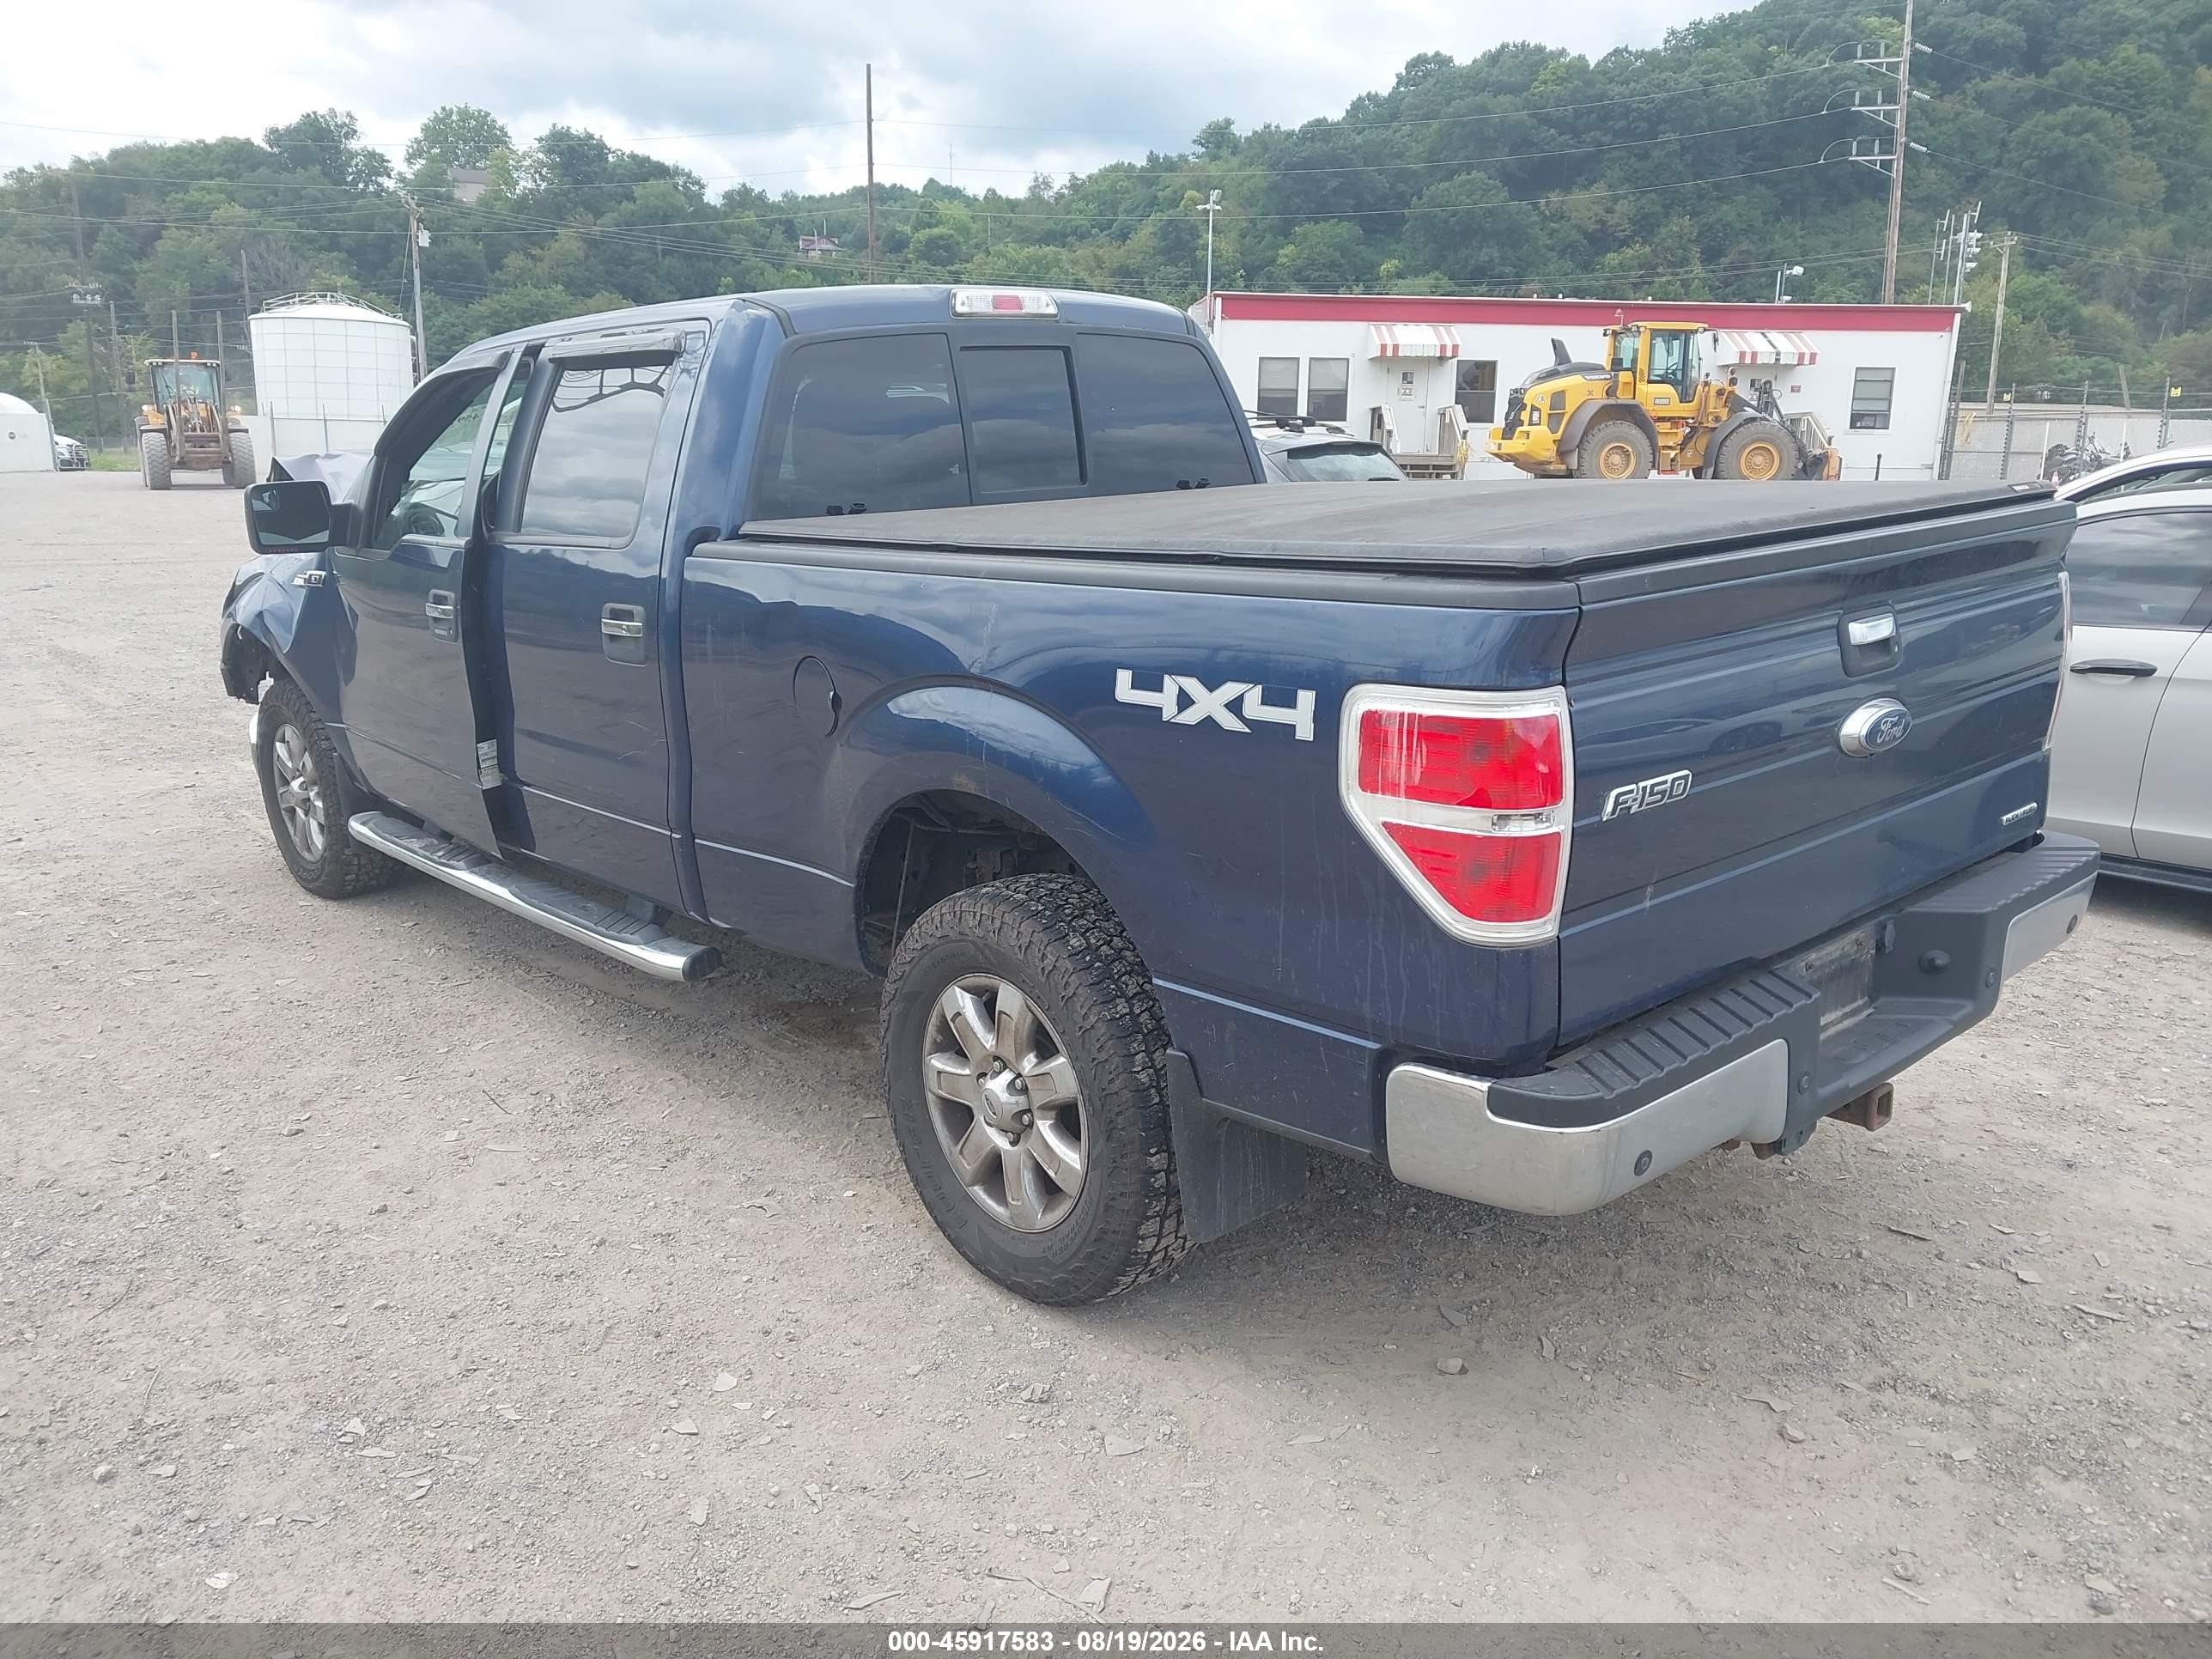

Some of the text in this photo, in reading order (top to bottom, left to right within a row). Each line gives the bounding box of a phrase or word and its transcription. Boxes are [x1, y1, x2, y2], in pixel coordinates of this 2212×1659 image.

[1877, 714, 1905, 744] Ford
[1601, 769, 1692, 822] F-150
[2005, 805, 2036, 823] FLEX FUEL
